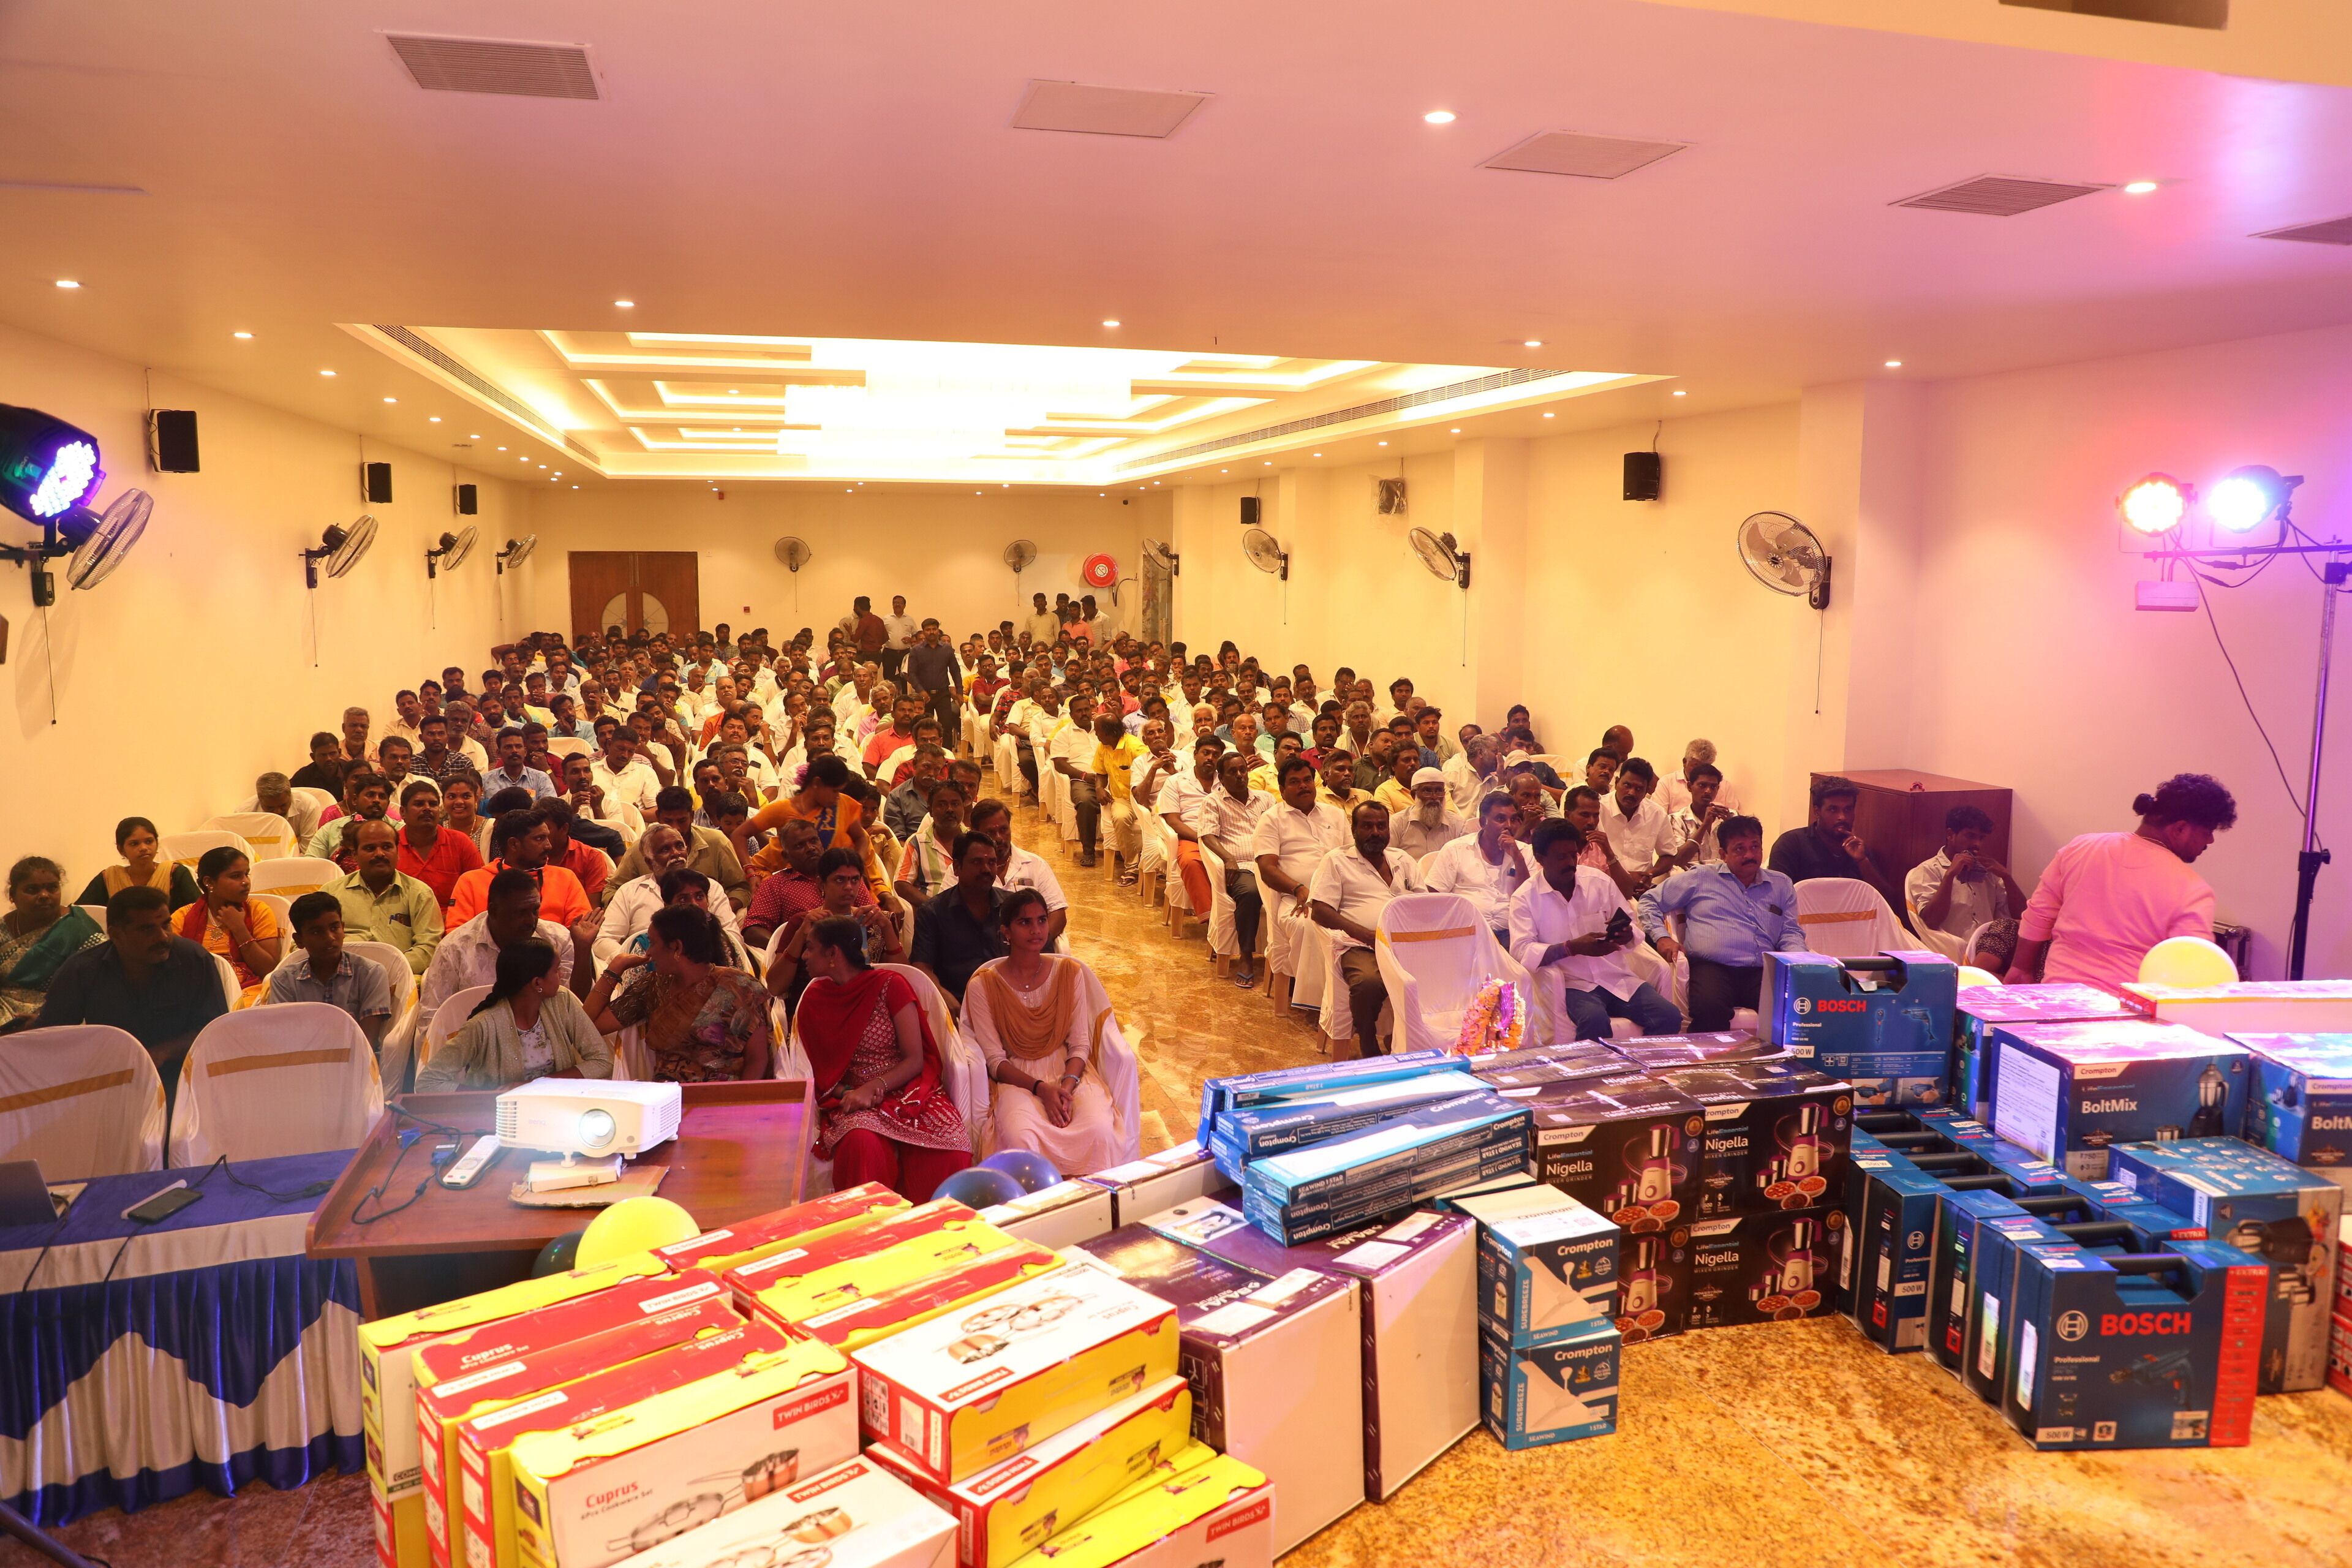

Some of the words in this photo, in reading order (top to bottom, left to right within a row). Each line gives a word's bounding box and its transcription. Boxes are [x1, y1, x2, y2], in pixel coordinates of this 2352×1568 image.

[1817, 999, 1867, 1012] BOSCH
[1550, 1041, 1591, 1051] Nigella
[2080, 1067, 2117, 1076] Crompton
[1602, 1075, 1648, 1085] Nigella
[1430, 1093, 1488, 1112] Crompton
[2081, 1098, 2138, 1114] BoltMix
[1251, 1114, 1315, 1129] Crompton
[1493, 1115, 1525, 1131] Crompton
[1543, 1130, 1583, 1141] Crompton
[1705, 1125, 1749, 1135] LifeEssential
[1259, 1136, 1297, 1148] Crompton
[1498, 1139, 1523, 1153] SEAWIND
[1705, 1136, 1749, 1153] Nigella
[1482, 1150, 1494, 1159] STAR
[1547, 1149, 1593, 1161] LifeEssential
[1482, 1167, 1494, 1177] STAR
[1498, 1158, 1521, 1171] SEAWIND
[1545, 1159, 1593, 1178] Nigella
[1298, 1180, 1325, 1194] SEAWIND
[1329, 1174, 1344, 1185] STAR
[1564, 1174, 1593, 1183] GRINDER
[1291, 1202, 1329, 1218] Crompton
[1517, 1207, 1574, 1220] Crompton
[1293, 1224, 1331, 1240] Crompton
[1693, 1223, 1730, 1232] Crompton
[1332, 1230, 1377, 1249] BAJAJ
[1557, 1238, 1613, 1257] Crompton
[1696, 1241, 1740, 1251] LifeEssential
[1695, 1251, 1740, 1267] Nigella
[1199, 1287, 1253, 1311] BAJAJ
[1521, 1279, 1529, 1330] SUREBREEZE
[655, 1309, 701, 1325] Cuprus
[1593, 1319, 1607, 1327] STAR
[2100, 1312, 2192, 1336] BOSCH
[698, 1331, 745, 1351] Cuprus
[1533, 1330, 1559, 1340] SEAWIND
[461, 1343, 513, 1364] Cuprus
[1554, 1344, 1613, 1362] Crompton
[777, 1406, 803, 1423] TWIN
[804, 1394, 832, 1412] BIRDS
[1516, 1382, 1525, 1431] SUREBREEZE
[1528, 1433, 1556, 1442] SEAWIND
[2046, 1431, 2062, 1439] 500
[586, 1481, 639, 1508] Cuprus
[793, 1483, 821, 1501] TWIN
[820, 1472, 850, 1491] BIRDS
[601, 1496, 639, 1513] Cookware
[643, 1488, 654, 1498] Set
